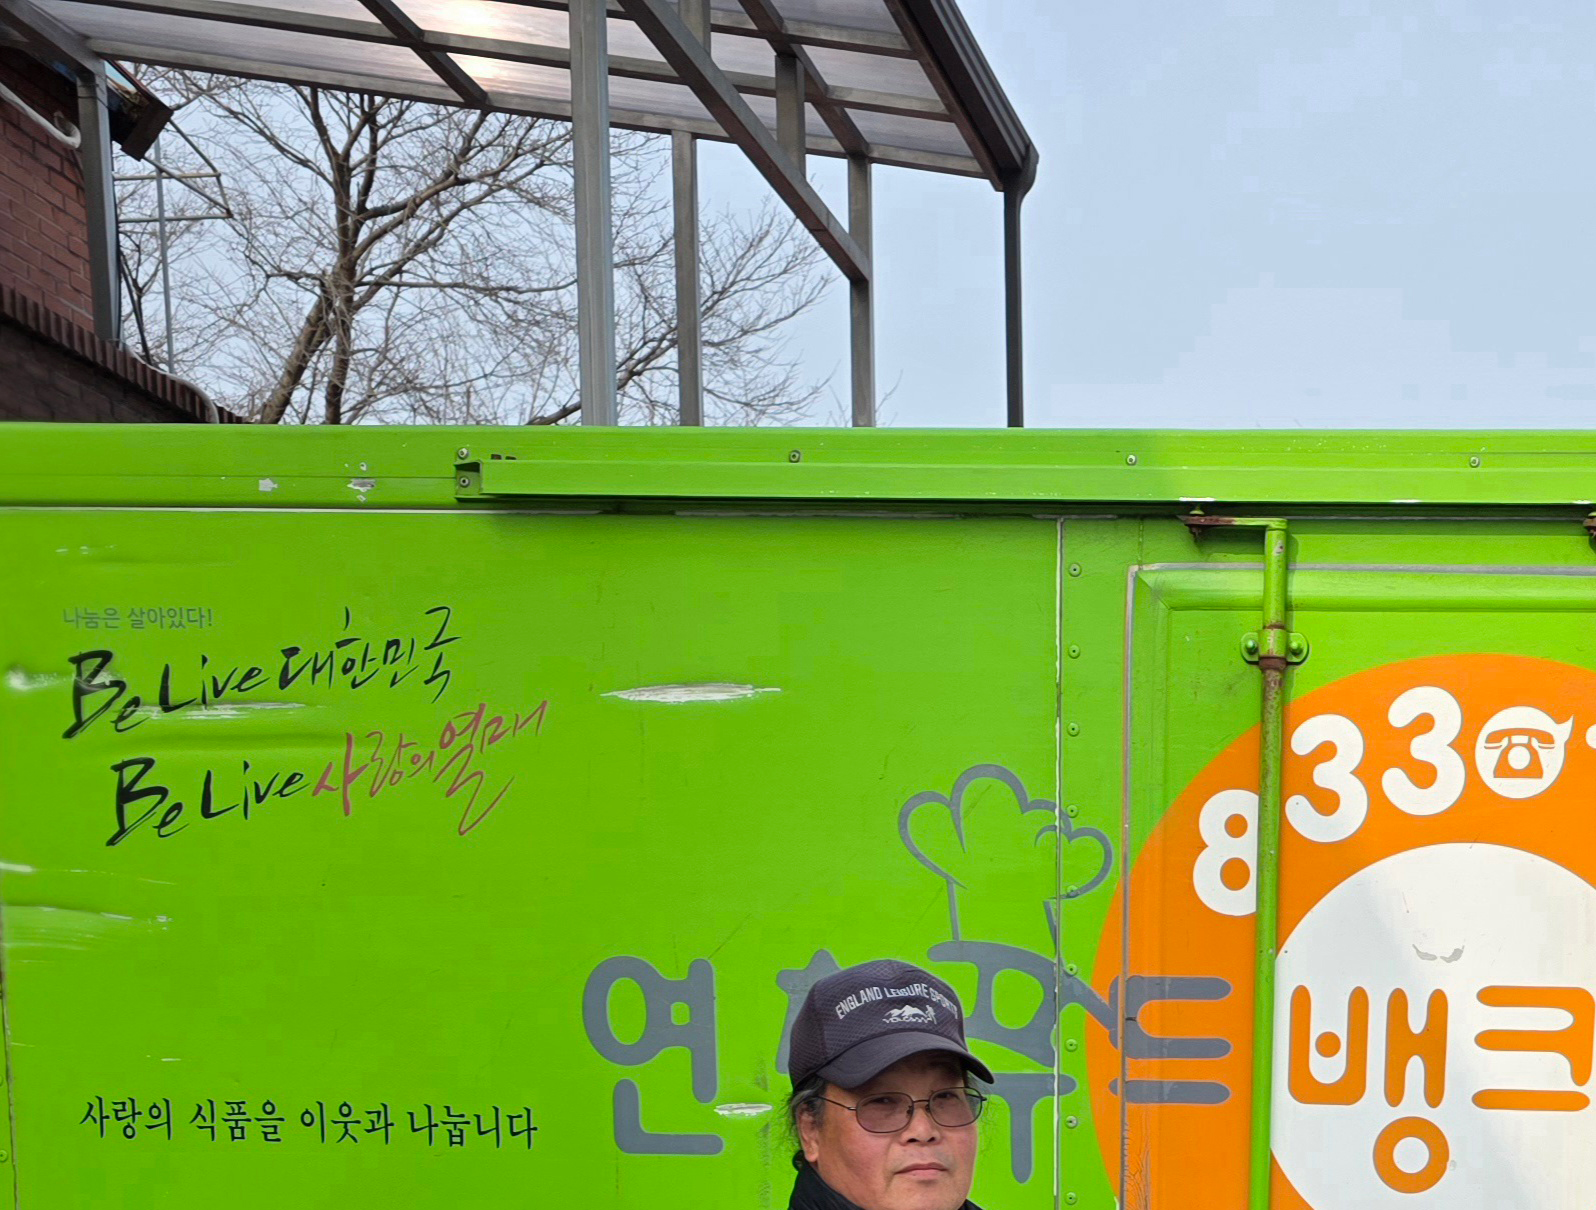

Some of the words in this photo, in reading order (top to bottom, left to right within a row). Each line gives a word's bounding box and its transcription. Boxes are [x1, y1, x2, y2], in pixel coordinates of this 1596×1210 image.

[63, 607, 121, 629] 나눔은
[128, 607, 213, 629] 살아있다!
[279, 605, 462, 703] 대한민국
[835, 986, 883, 1020] ENGLAND
[884, 983, 930, 998] LEISURE
[80, 1095, 173, 1141] 사랑의
[190, 1098, 286, 1143] 식품을
[300, 1100, 395, 1145] 이웃과
[407, 1103, 538, 1150] 나눕니다
